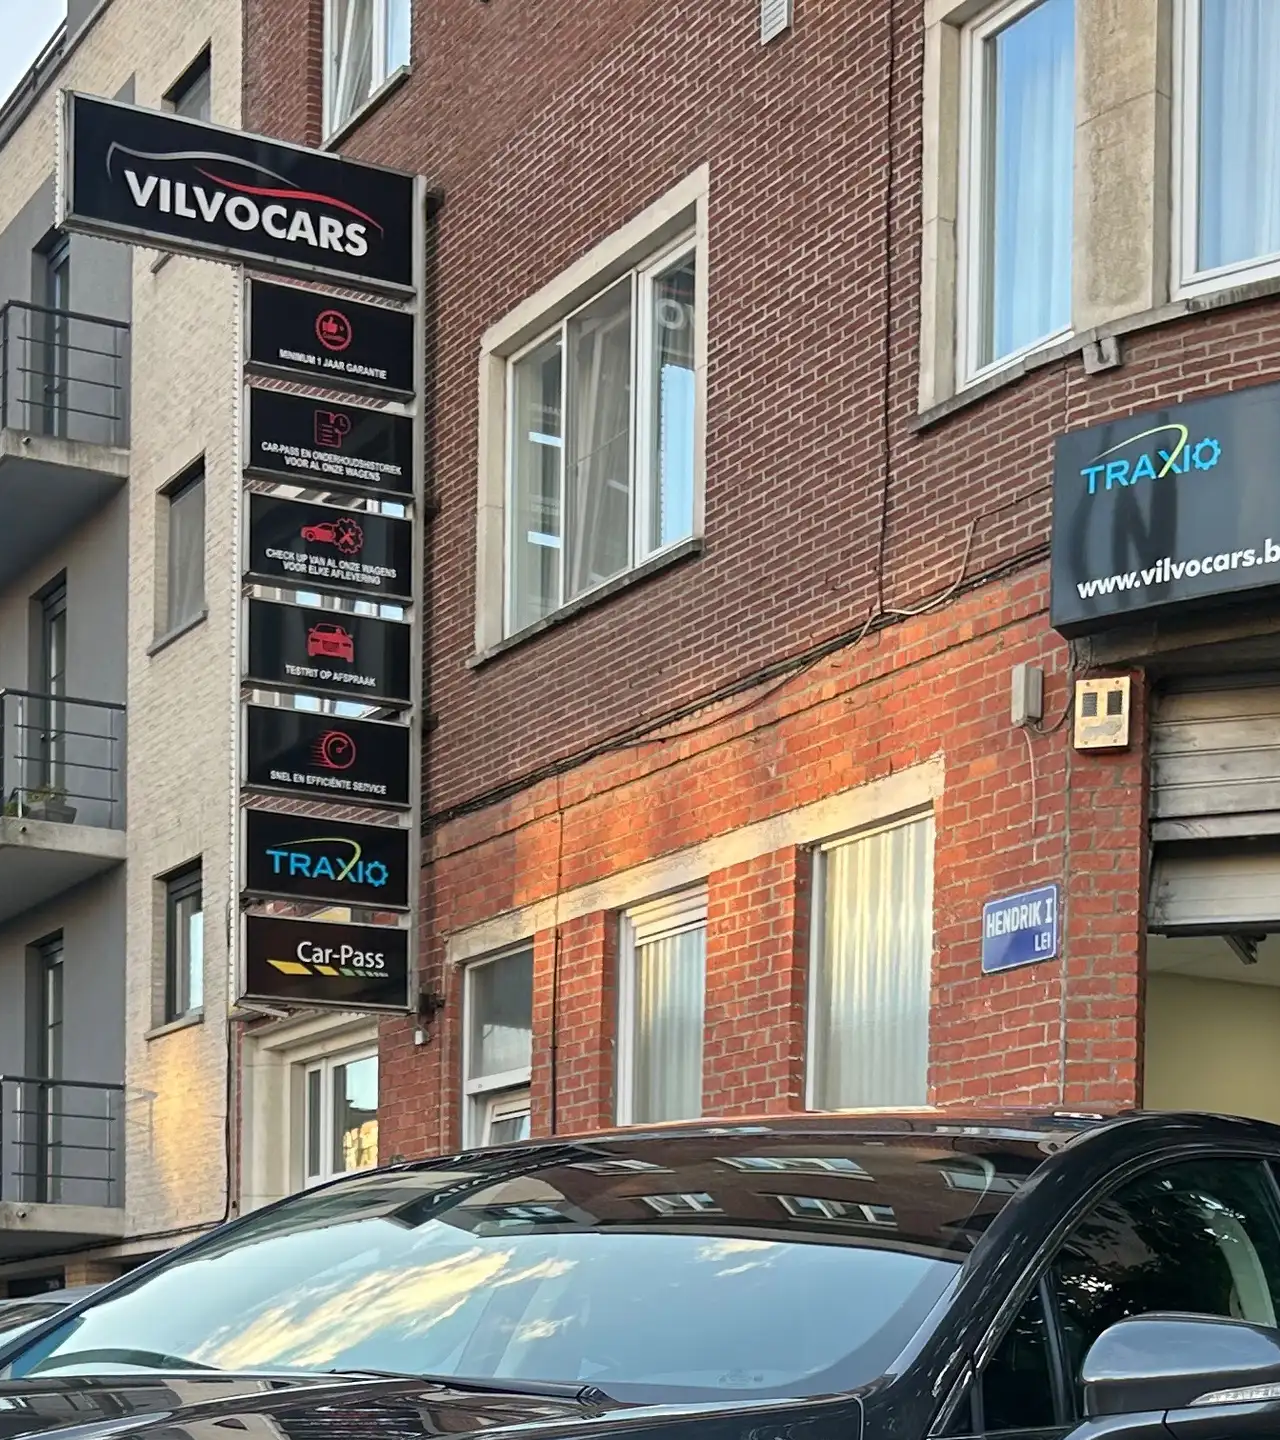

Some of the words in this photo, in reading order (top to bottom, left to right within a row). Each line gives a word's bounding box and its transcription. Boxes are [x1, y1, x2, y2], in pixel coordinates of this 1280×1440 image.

[123, 169, 368, 257] VILVOCARS
[278, 349, 316, 364] MINIMUM
[317, 356, 322, 366] 1
[323, 358, 345, 371] JAAR
[346, 363, 387, 380] GARANTIE
[261, 441, 299, 457] CAR-PASS
[301, 449, 311, 458] EN
[1080, 427, 1222, 495] TRAXIO
[284, 456, 309, 468] VOOR
[310, 461, 320, 471] AL
[322, 463, 344, 475] ONZE
[345, 467, 380, 482] WAGENS
[265, 548, 295, 561] CHECK
[296, 552, 308, 563] UP
[309, 554, 326, 567] VAN
[327, 558, 337, 568] AL
[338, 560, 360, 572] ONZE
[362, 564, 397, 579] WAGENS
[282, 560, 307, 573] VOOR
[308, 564, 330, 577] ELKE
[331, 569, 381, 586] AFLEVERING
[285, 664, 318, 678] TESTRIT
[319, 669, 331, 680] OP
[332, 672, 376, 687] AFSPRAAK
[270, 770, 291, 782] SNEL
[293, 773, 305, 784] EN
[352, 781, 387, 795] SERVICE
[265, 842, 389, 888] TRAXIO
[986, 900, 1041, 938] HENDRIK
[1045, 898, 1053, 924] I
[296, 940, 385, 969] Car-Pass
[1034, 932, 1051, 952] LEI
